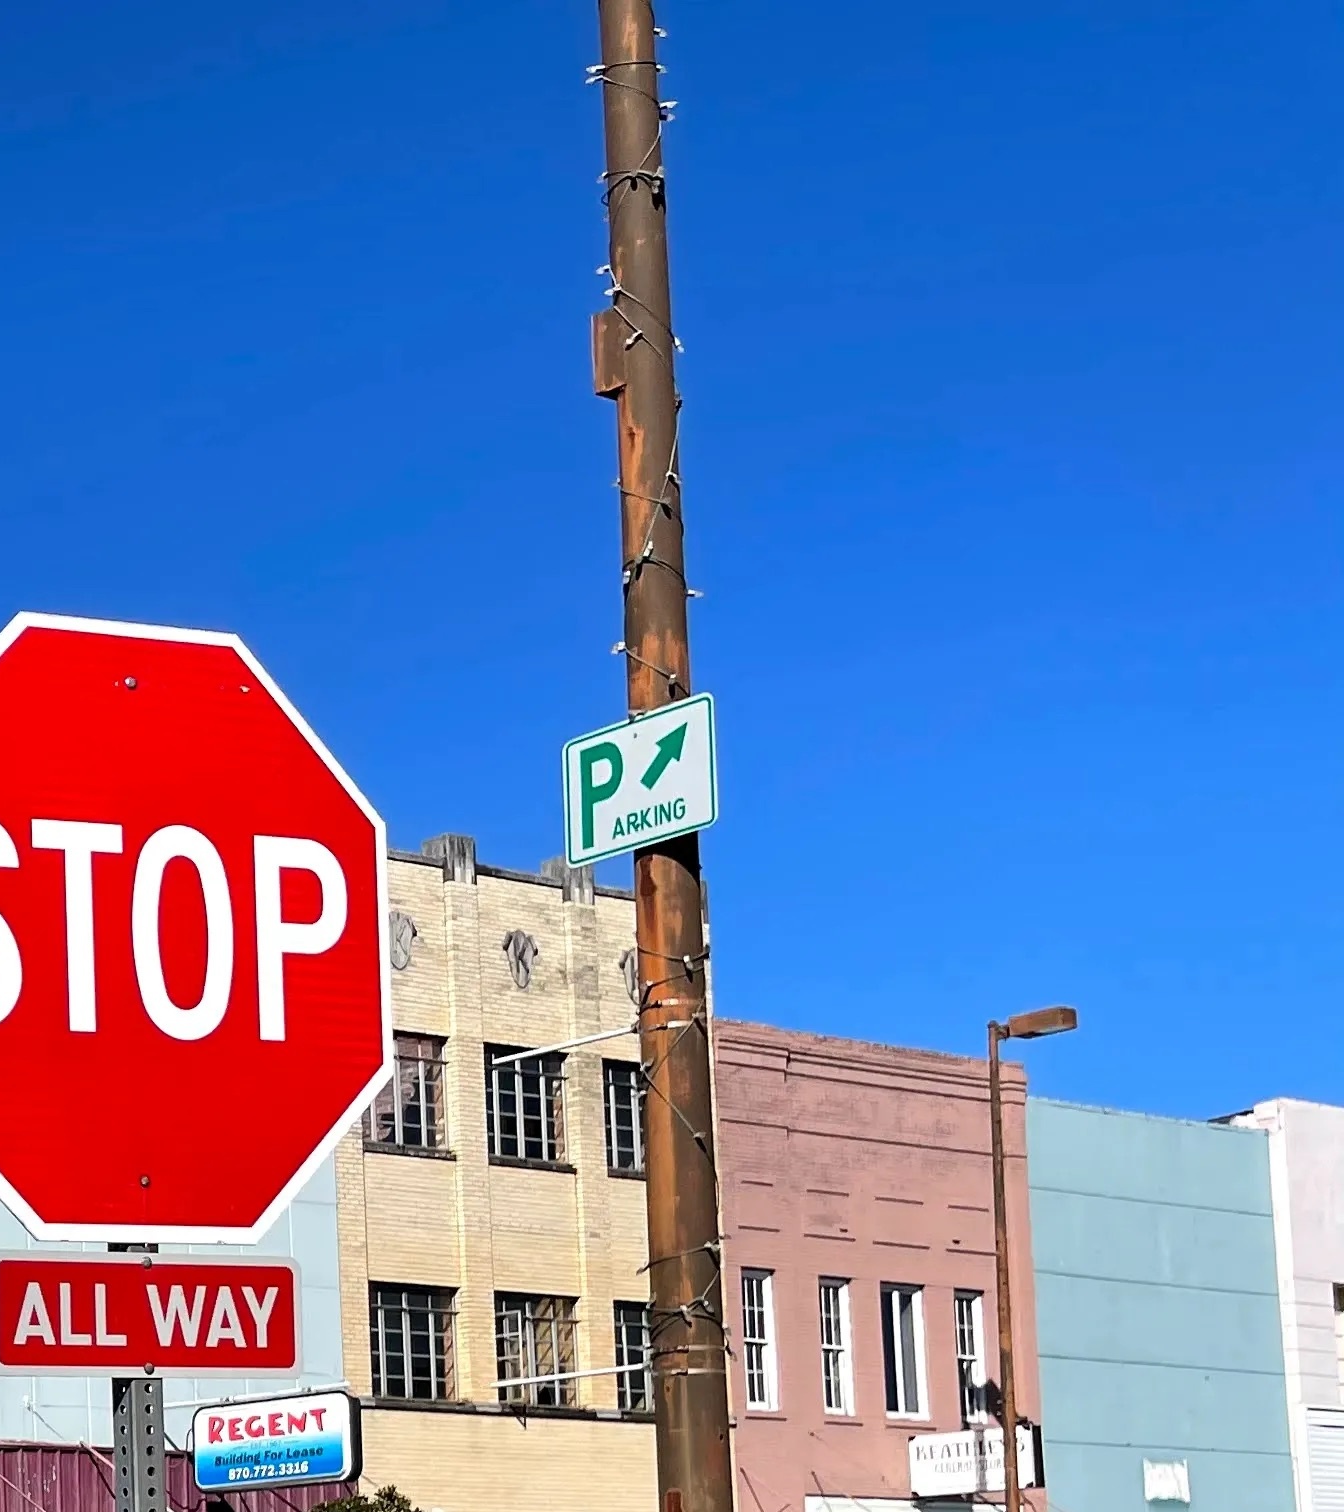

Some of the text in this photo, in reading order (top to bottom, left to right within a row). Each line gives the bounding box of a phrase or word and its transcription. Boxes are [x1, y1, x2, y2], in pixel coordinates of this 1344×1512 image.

[13, 1282, 279, 1348] ALL WAY
[208, 1408, 326, 1444] REGENT
[215, 1446, 323, 1467] Building For Lease
[228, 1460, 309, 1481] 870.772.3316
